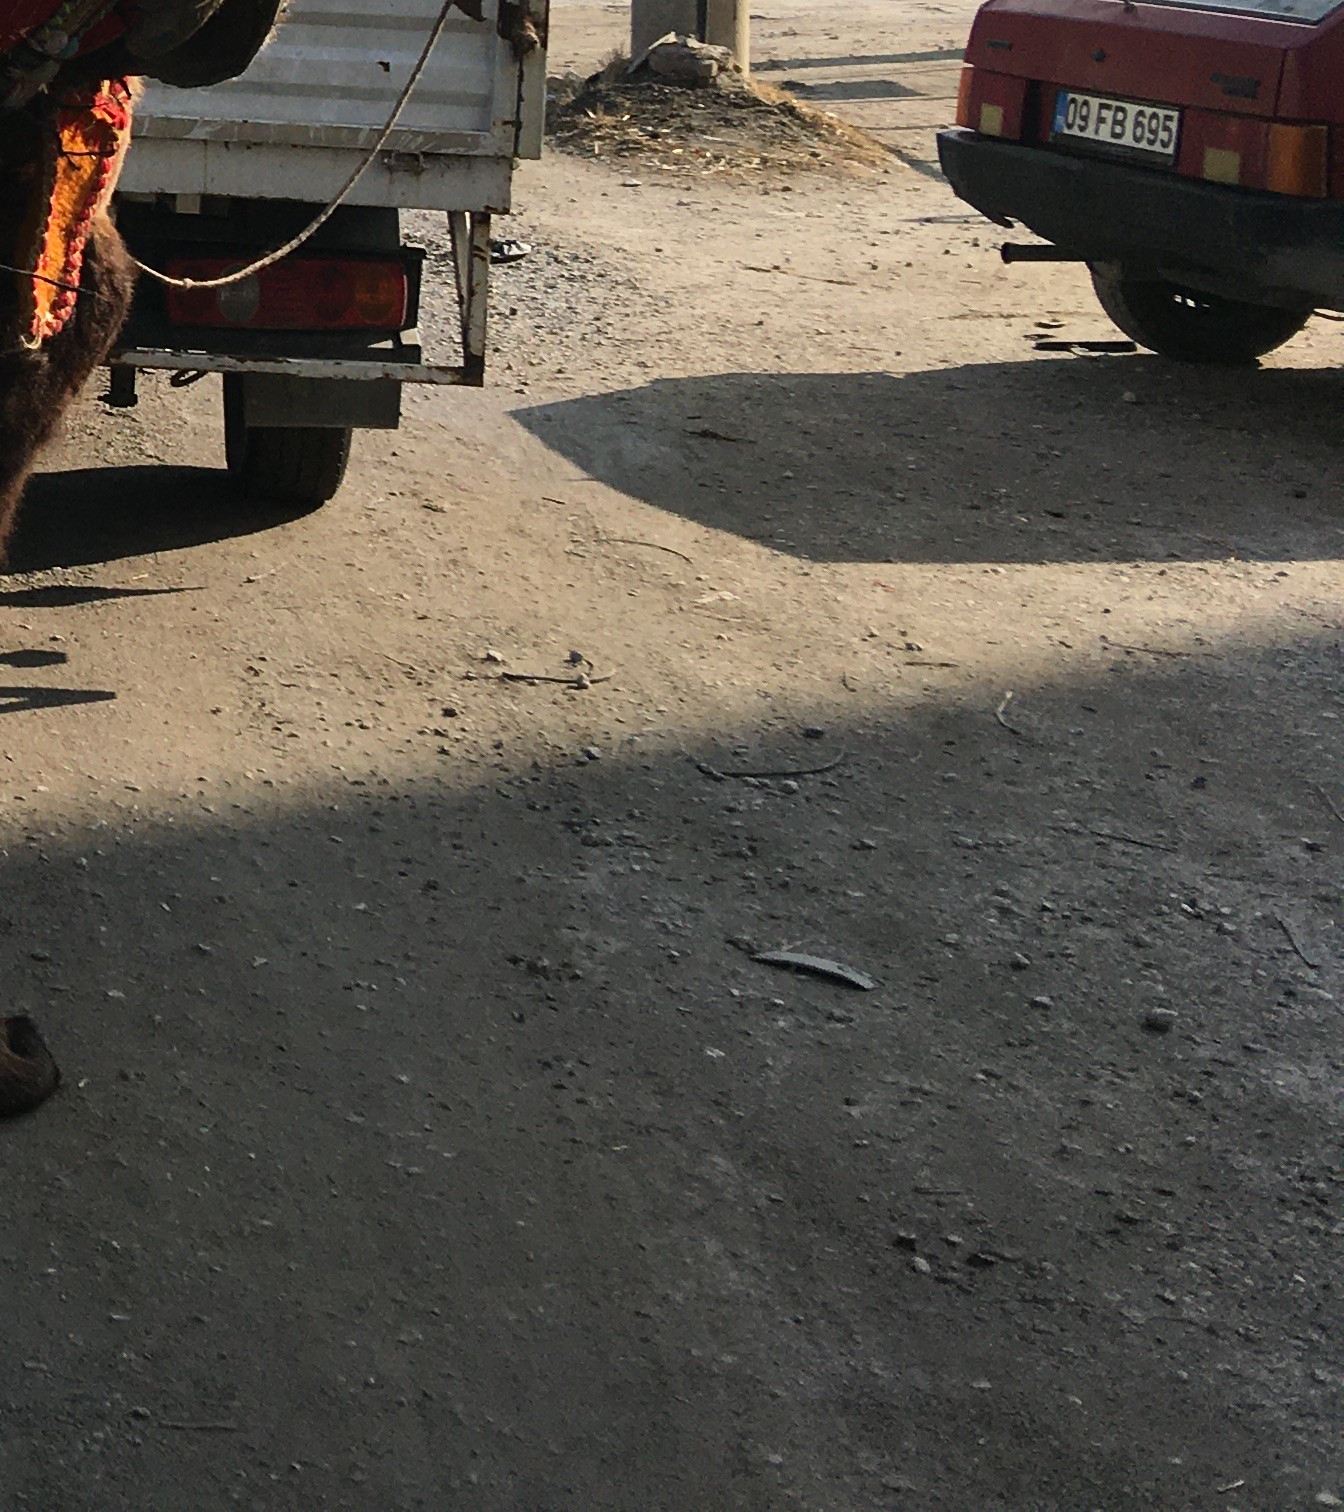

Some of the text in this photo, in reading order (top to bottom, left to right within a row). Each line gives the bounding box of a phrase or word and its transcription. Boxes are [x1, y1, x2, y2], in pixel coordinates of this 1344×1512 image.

[1065, 97, 1176, 149] 09 FB 695
